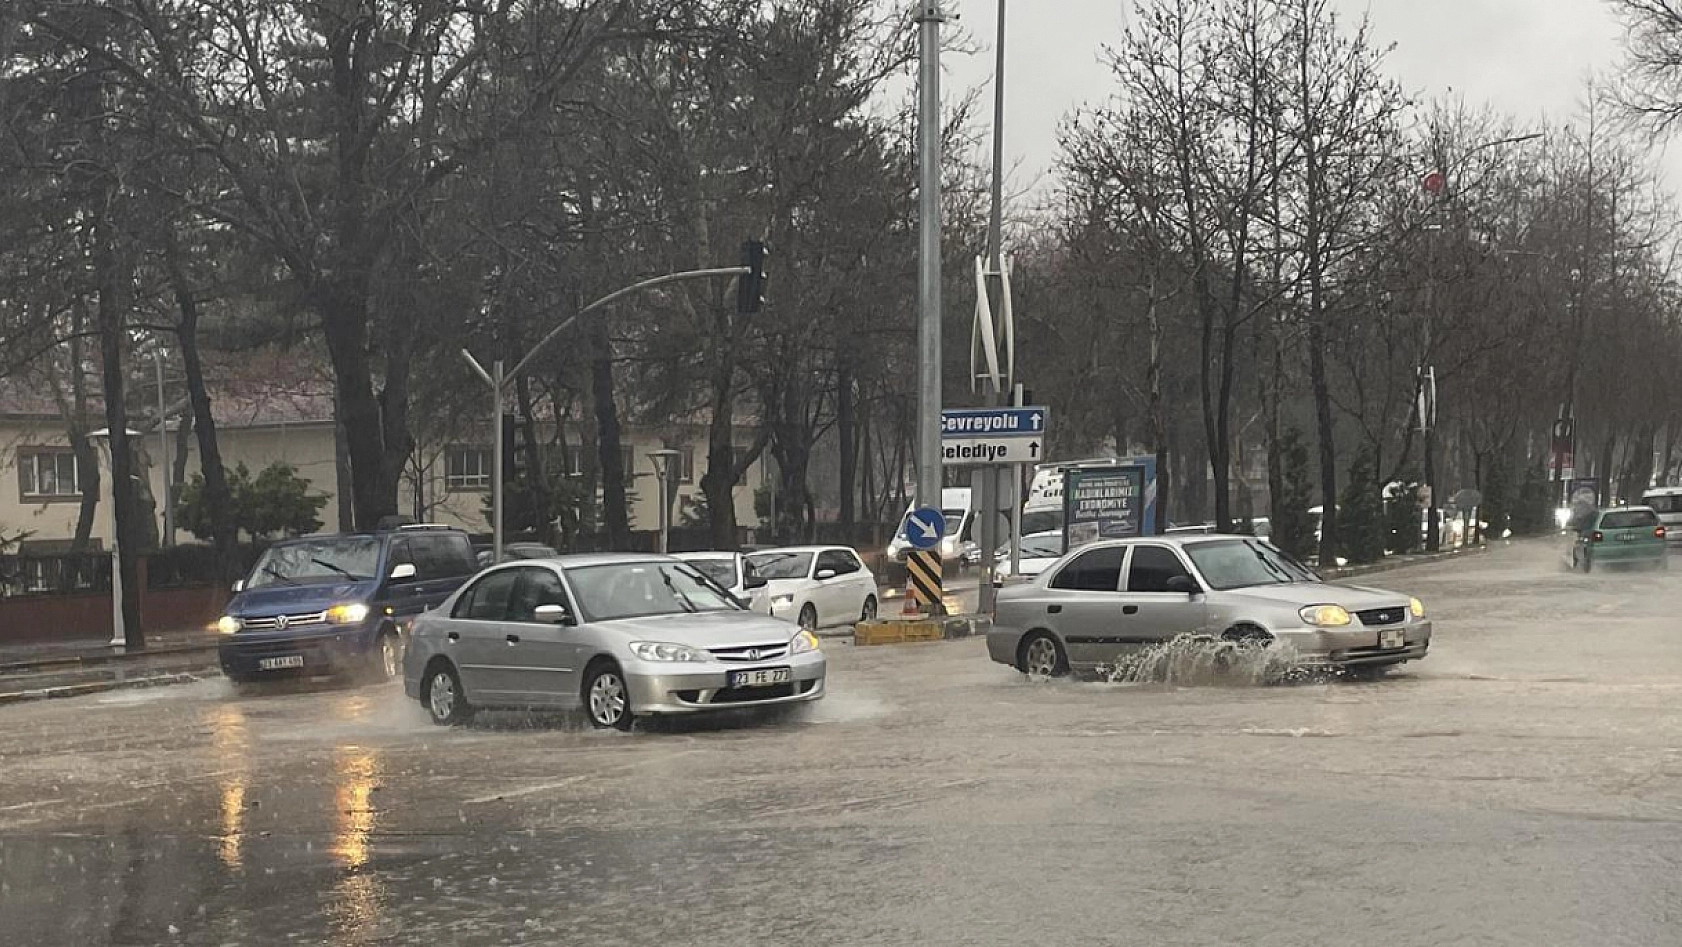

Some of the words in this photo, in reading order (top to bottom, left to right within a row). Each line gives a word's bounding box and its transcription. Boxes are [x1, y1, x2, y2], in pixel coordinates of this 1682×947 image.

[942, 442, 1007, 461] elediye
[736, 672, 748, 684] 23
[756, 671, 767, 682] FE
